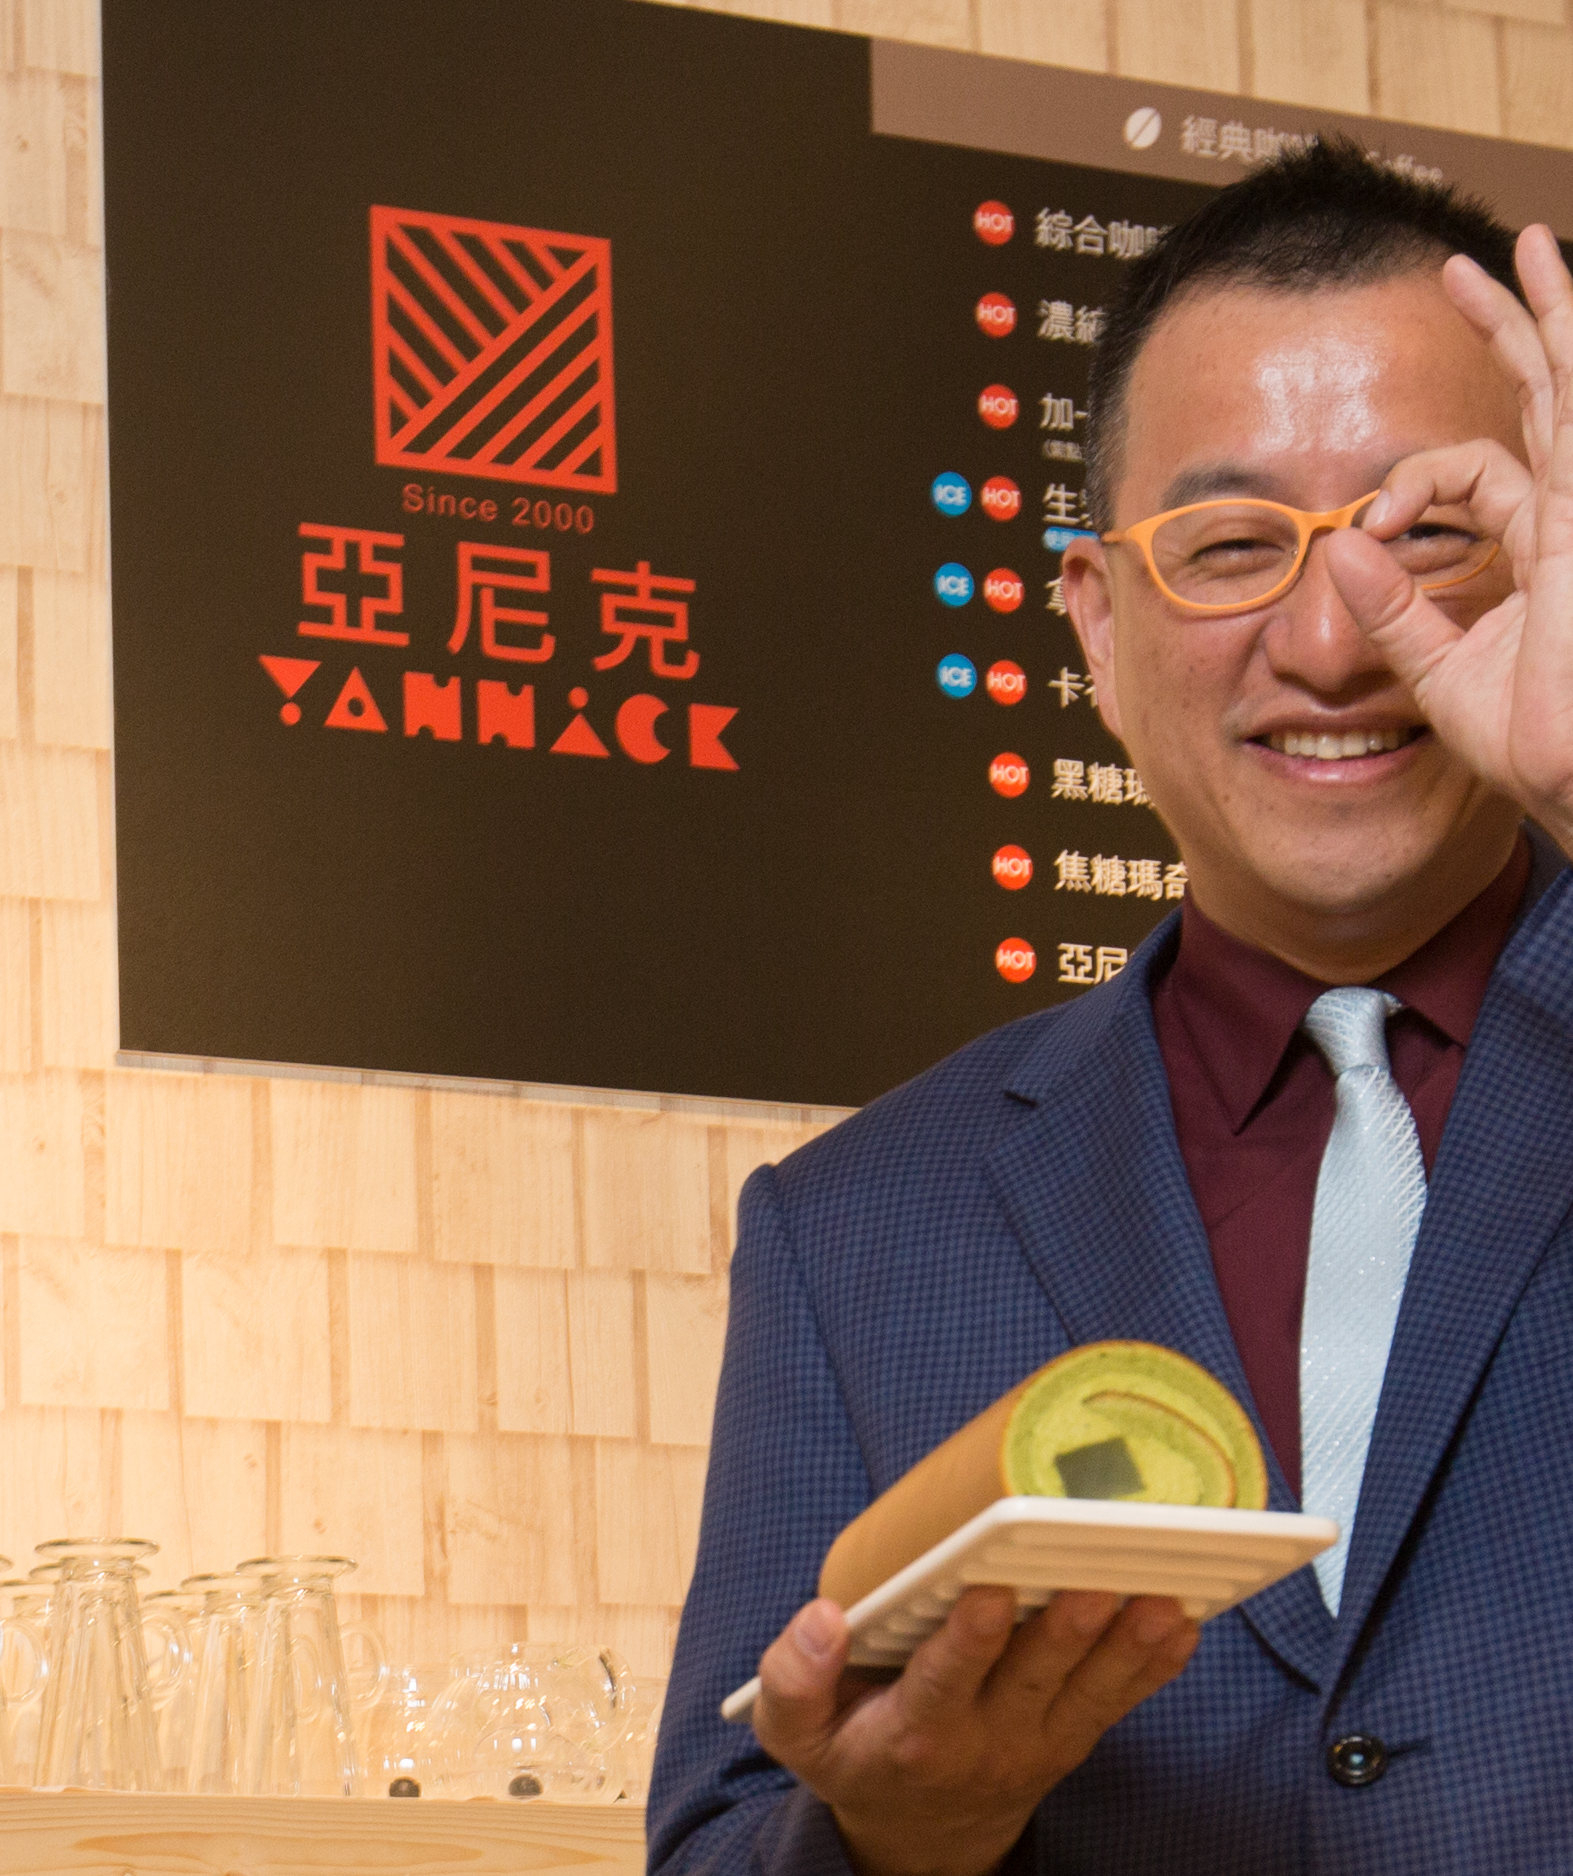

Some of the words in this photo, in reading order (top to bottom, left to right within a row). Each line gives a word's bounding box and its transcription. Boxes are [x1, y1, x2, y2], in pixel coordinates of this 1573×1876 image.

[975, 212, 1014, 235] HOT
[978, 304, 1017, 327] HOT
[979, 394, 1019, 416] HOT
[935, 484, 968, 505] ICE
[982, 488, 1021, 509] HOT
[402, 483, 498, 522] Since
[511, 497, 595, 535] 2000
[937, 575, 969, 597] ICE
[984, 580, 1024, 602] HOT
[297, 522, 701, 681] 亞尼克
[939, 666, 972, 689] ICE
[987, 671, 1026, 693] HOT
[990, 765, 1029, 786] HOT
[993, 857, 1032, 878] HOT
[997, 950, 1036, 970] HOT
